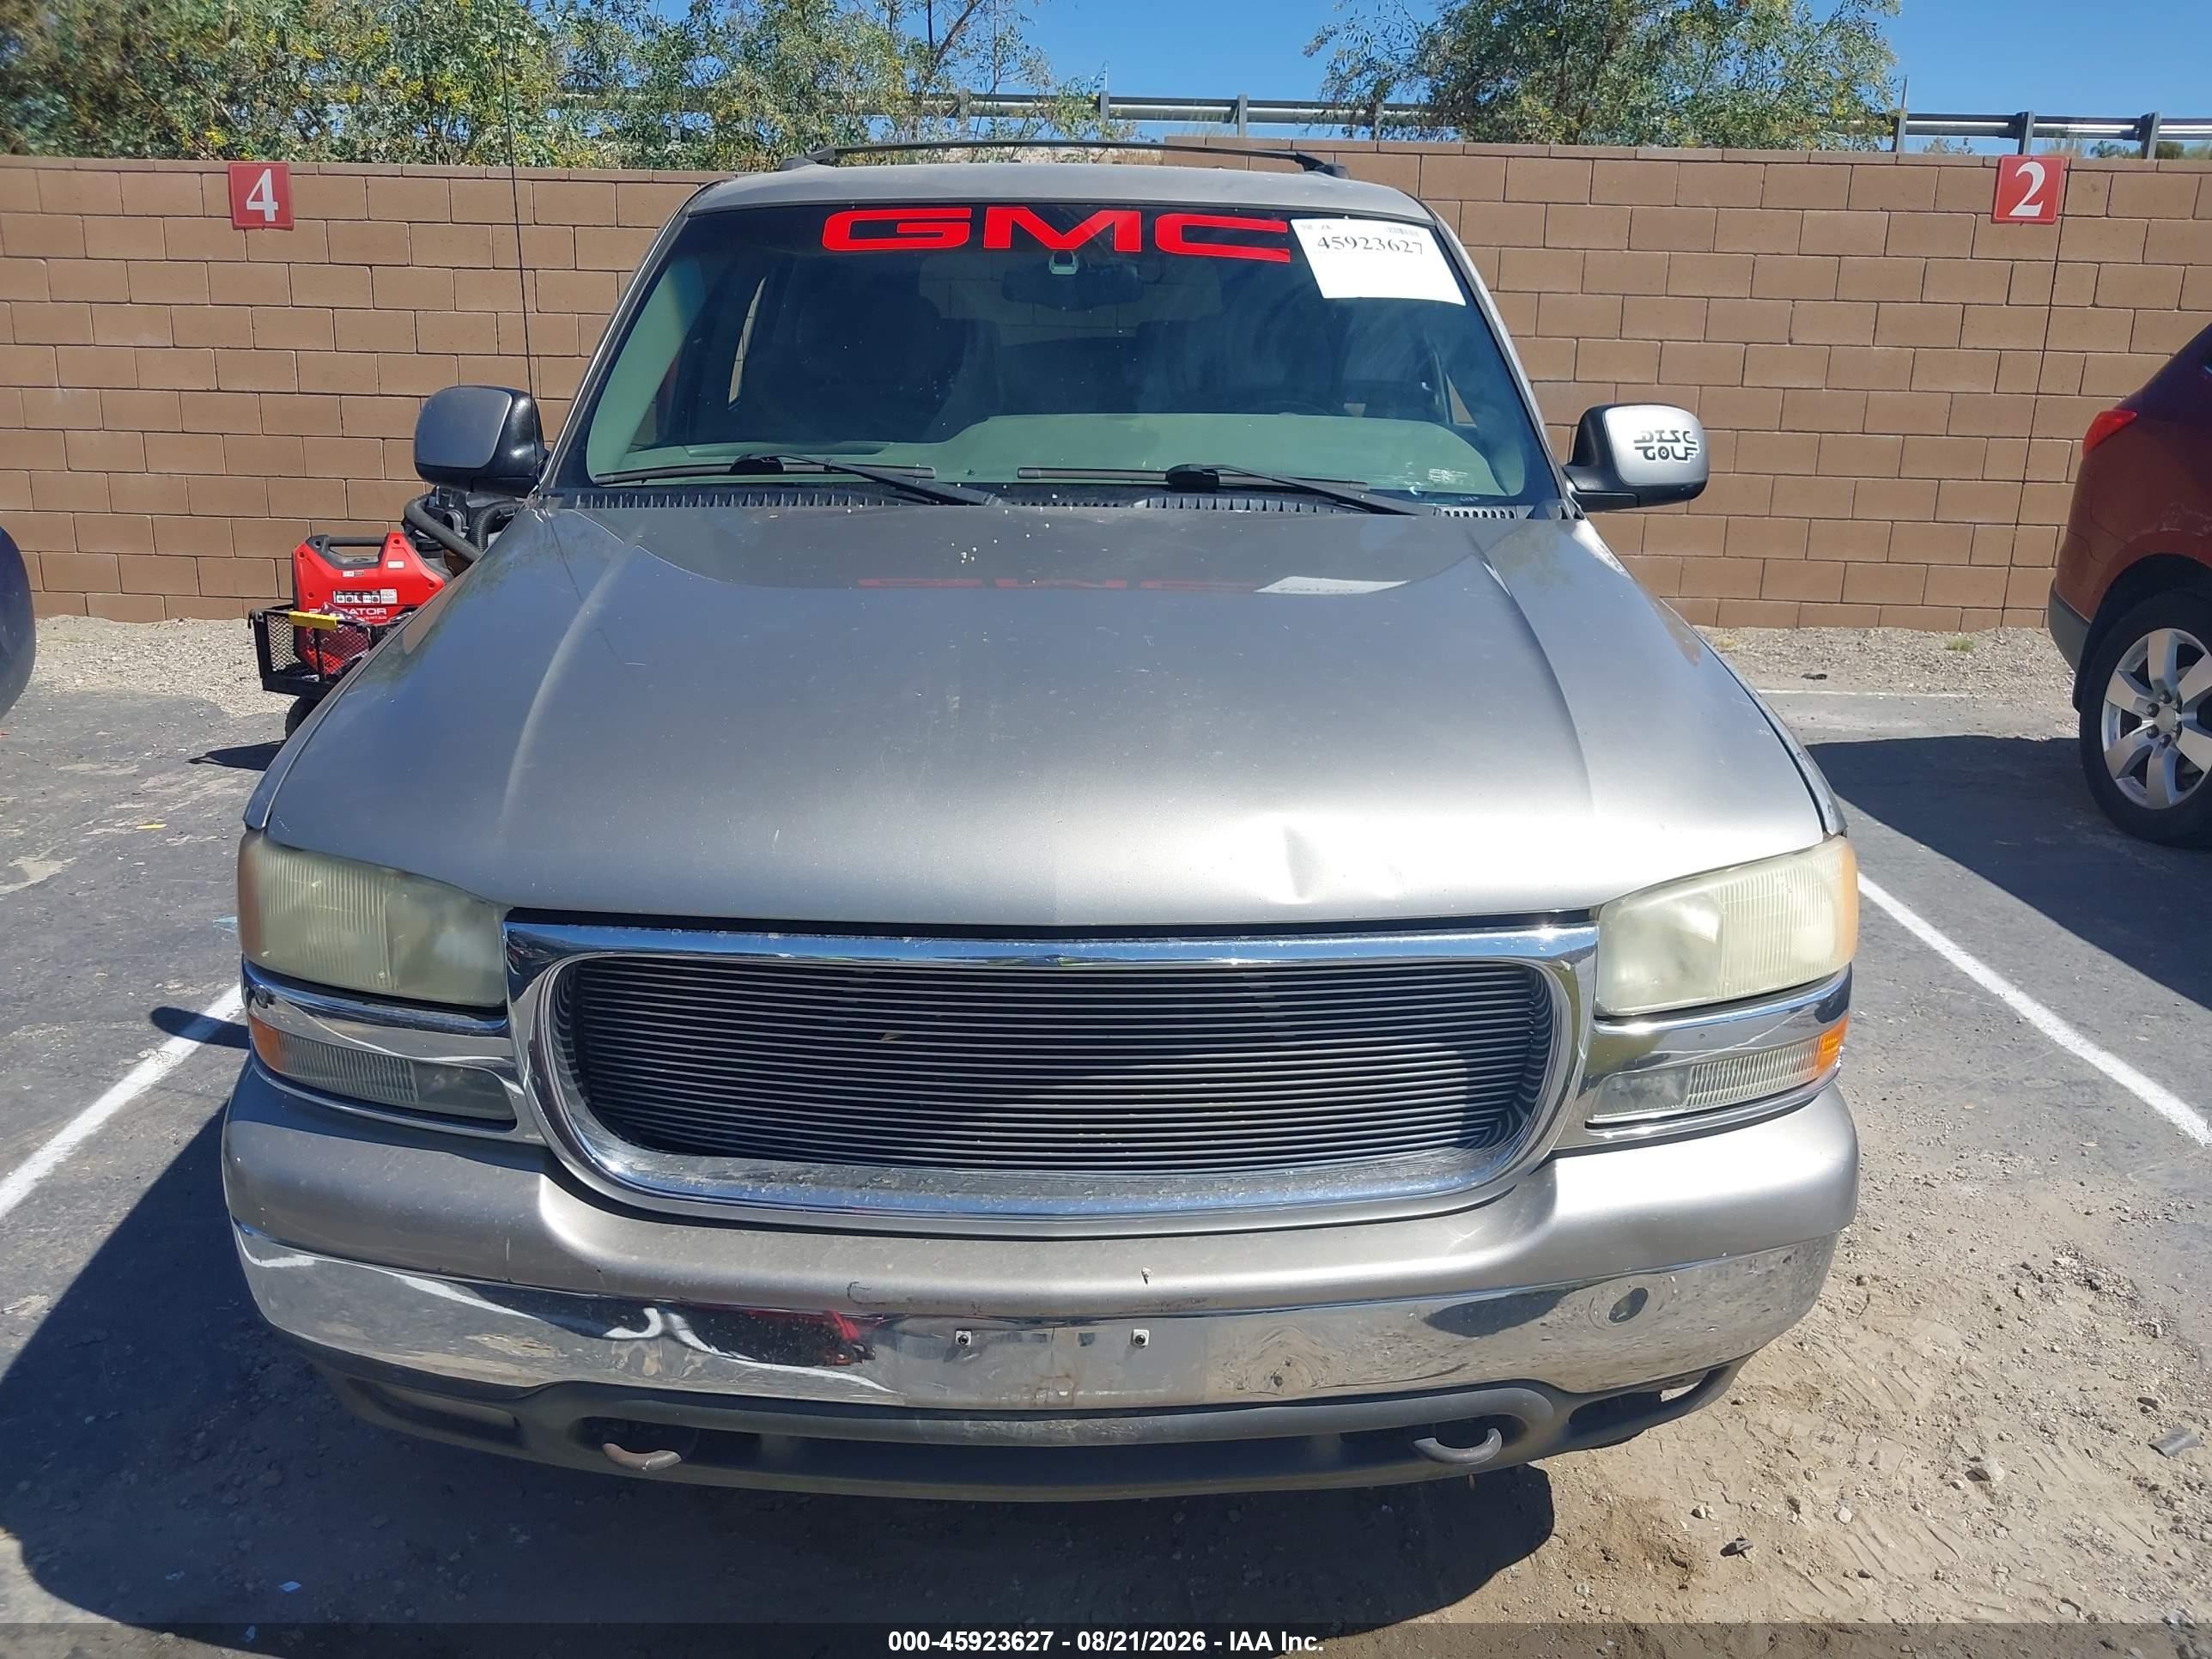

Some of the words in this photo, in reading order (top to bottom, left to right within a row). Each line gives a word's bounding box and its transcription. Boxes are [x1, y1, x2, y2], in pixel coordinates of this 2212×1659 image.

[246, 168, 279, 222] 4
[2008, 161, 2045, 216] 2
[822, 206, 1291, 263] GMC
[1317, 236, 1423, 254] 45923627
[1634, 446, 1698, 461] GOLF
